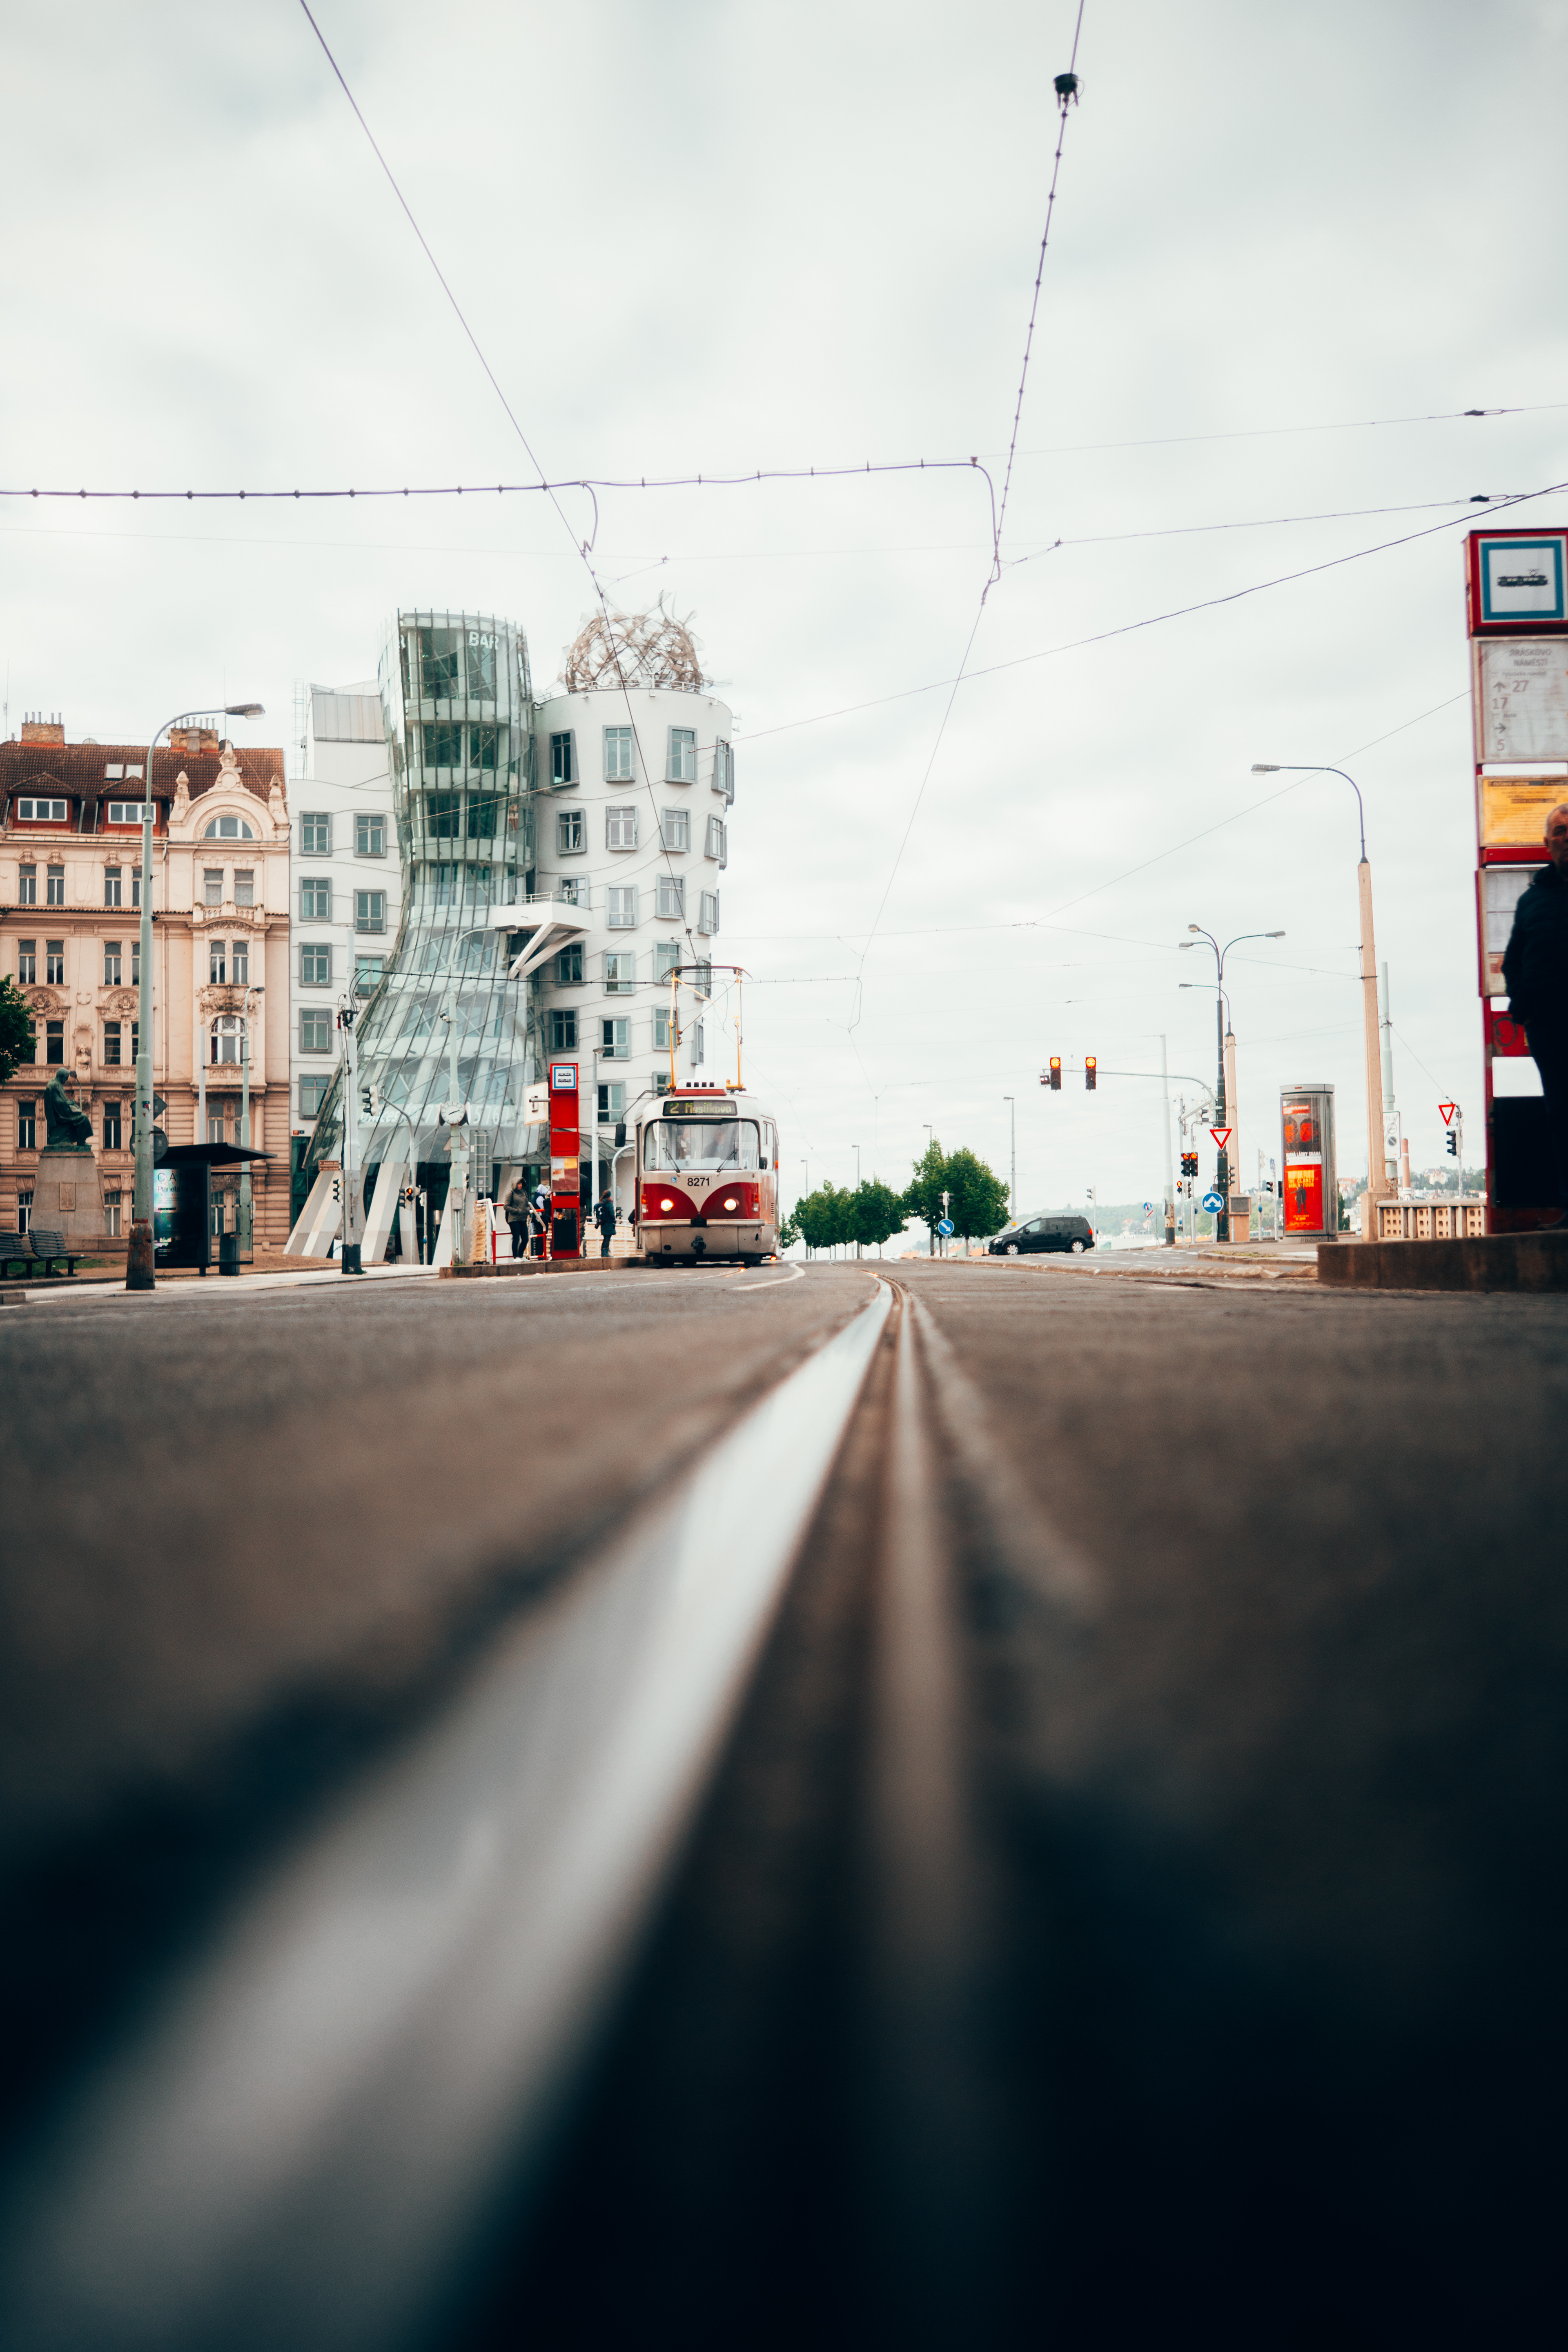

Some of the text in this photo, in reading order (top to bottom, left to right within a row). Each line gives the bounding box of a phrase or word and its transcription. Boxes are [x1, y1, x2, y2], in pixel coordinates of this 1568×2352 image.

[469, 631, 499, 650] BAR
[1512, 680, 1529, 693] 27
[1492, 697, 1509, 710] 17
[1496, 738, 1505, 752] 5
[670, 1102, 679, 1114] 2
[687, 1177, 710, 1187] 8271
